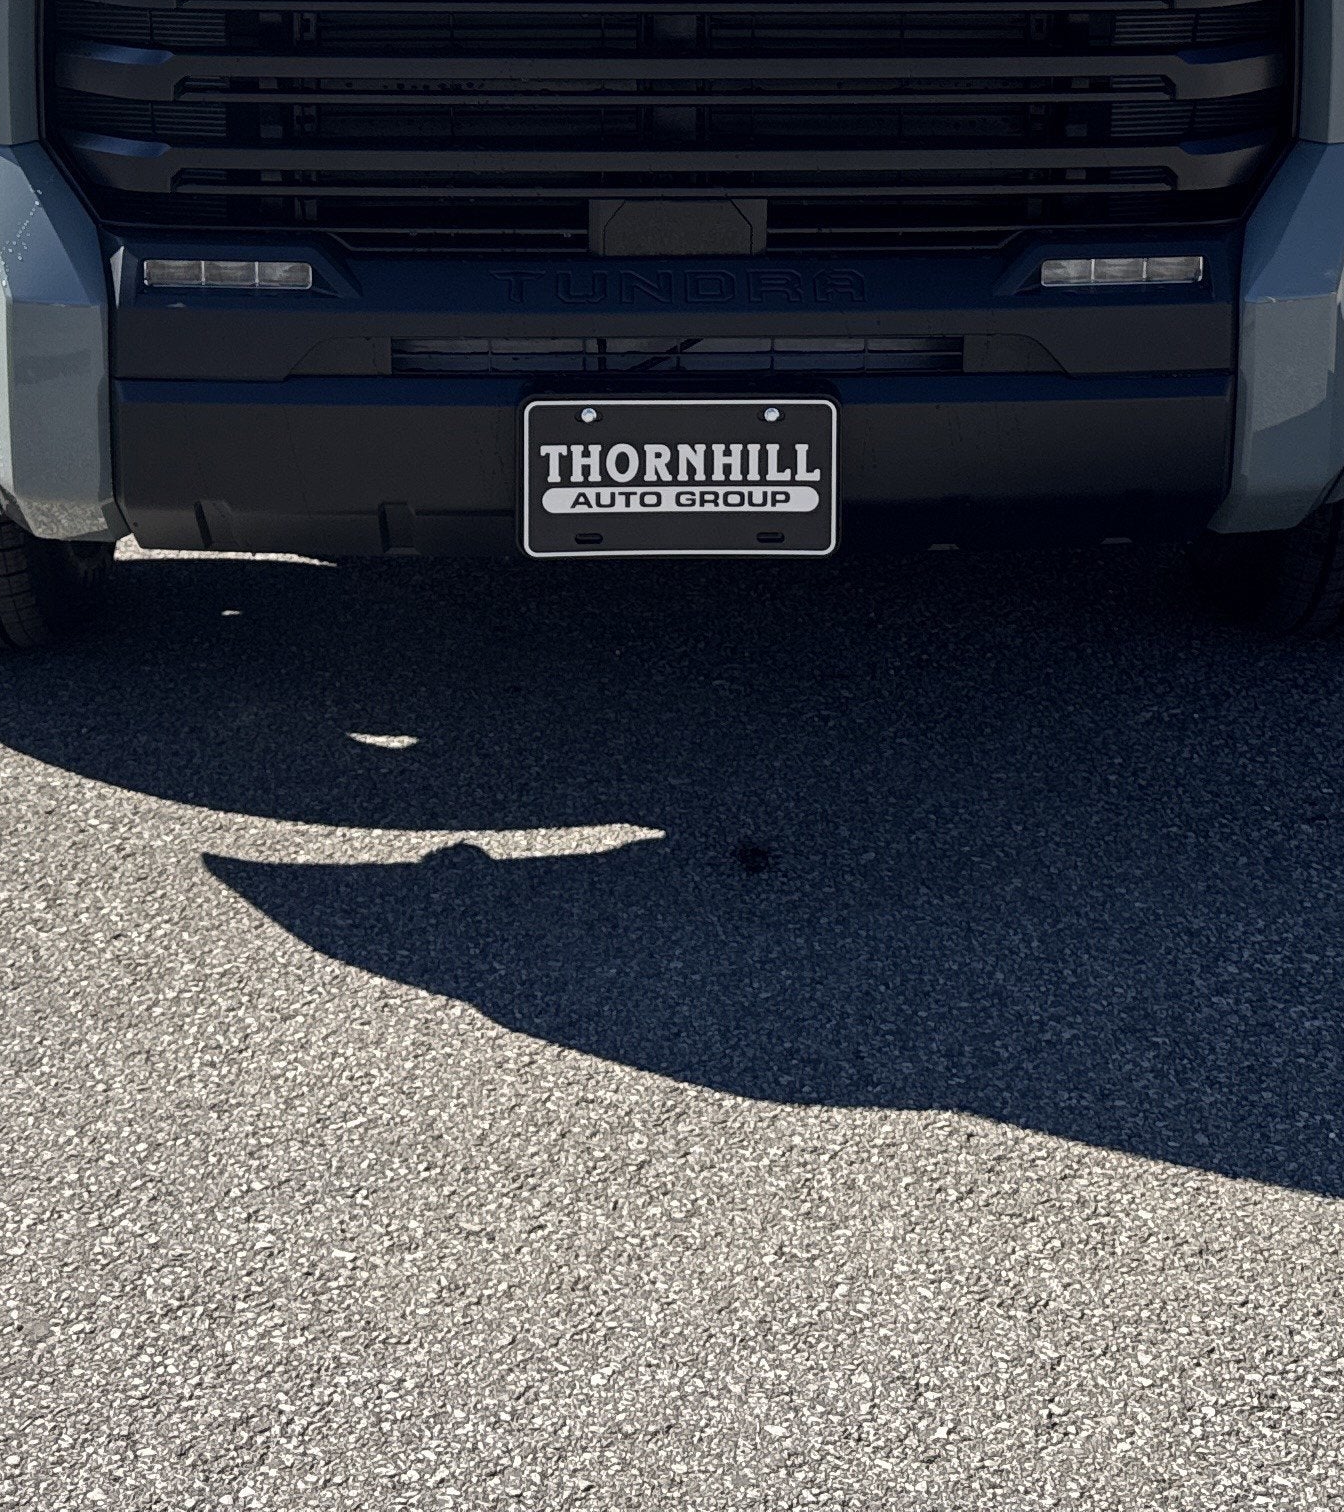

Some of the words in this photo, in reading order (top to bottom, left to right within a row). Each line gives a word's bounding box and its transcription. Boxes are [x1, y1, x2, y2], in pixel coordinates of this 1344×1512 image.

[487, 268, 868, 305] TUNDRA
[540, 443, 821, 483] THORNHILL
[570, 490, 663, 509] AUTO
[675, 490, 791, 509] GROUP
